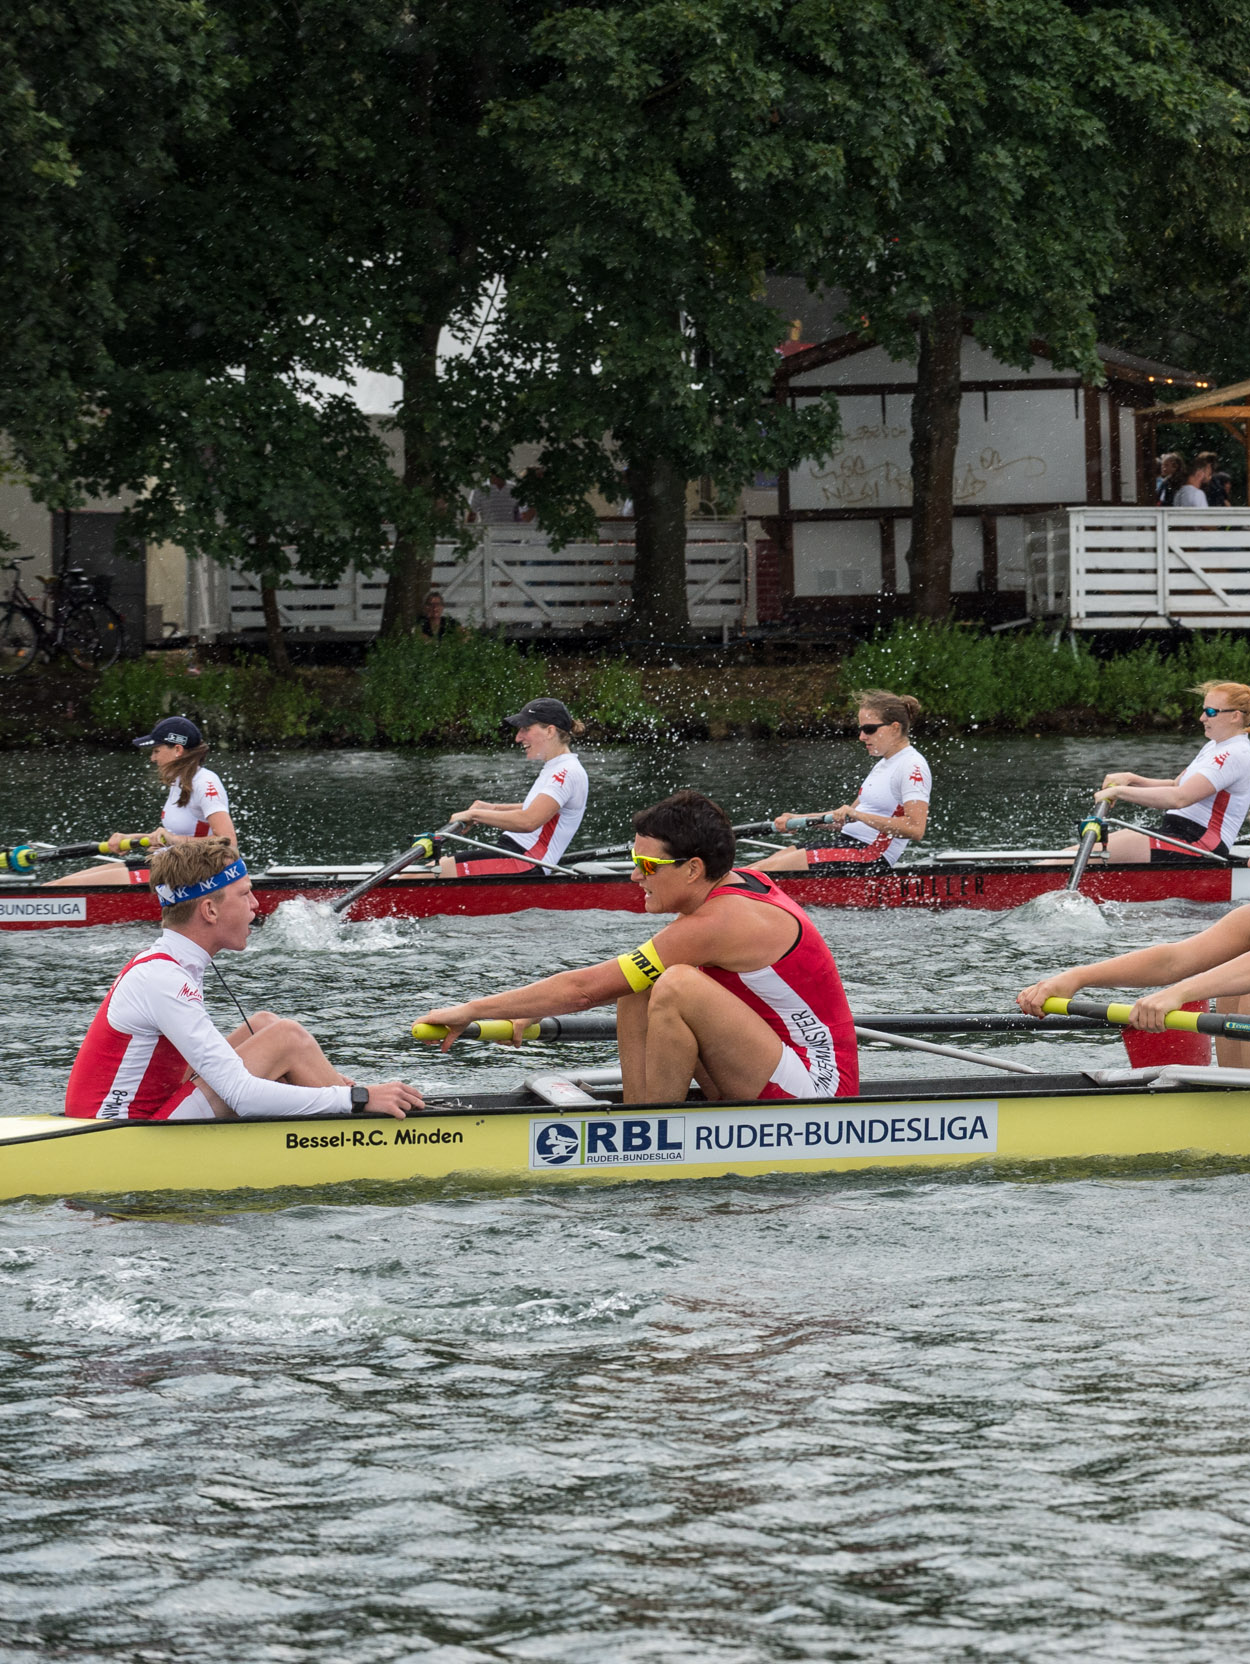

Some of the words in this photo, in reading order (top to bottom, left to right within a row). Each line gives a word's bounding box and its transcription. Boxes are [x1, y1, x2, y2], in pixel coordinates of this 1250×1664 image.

[223, 865, 241, 881] NK
[200, 876, 219, 892] NK
[285, 1130, 388, 1149] Bessel-R.C.
[394, 1128, 464, 1146] Minden
[587, 1119, 682, 1154] RBL
[696, 1115, 988, 1150] RUDER-BUNDESLIGA
[586, 1152, 682, 1163] RUDER-BUNDESLIGA
